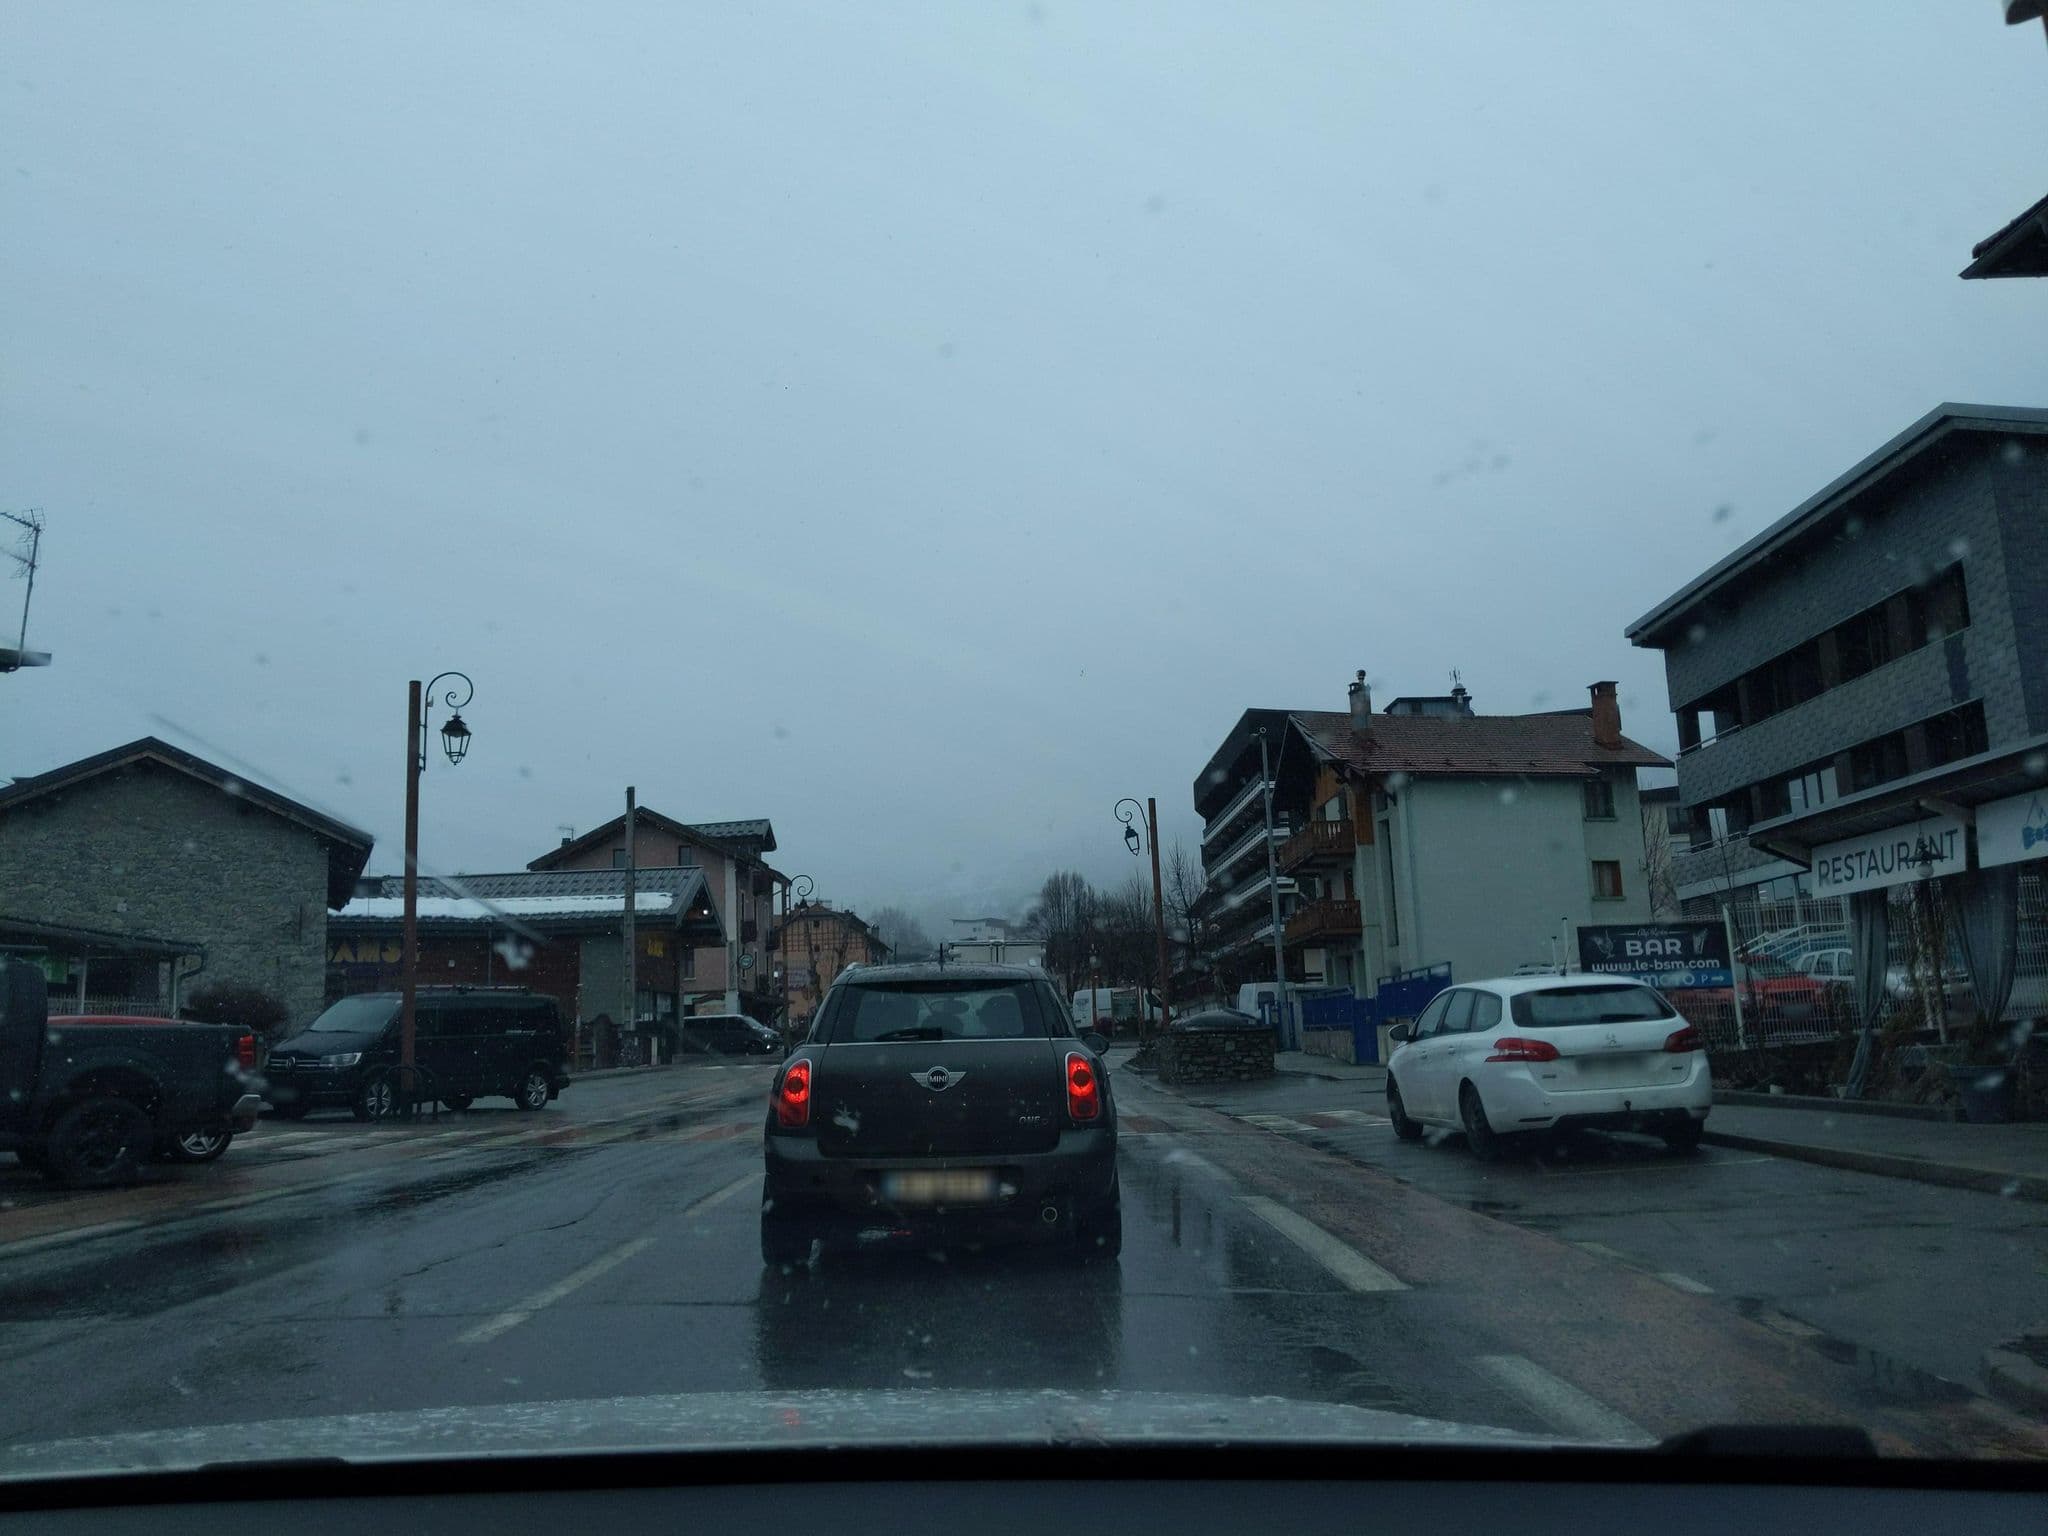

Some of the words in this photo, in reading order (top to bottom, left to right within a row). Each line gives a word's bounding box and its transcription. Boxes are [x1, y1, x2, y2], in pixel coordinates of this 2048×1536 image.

[1818, 828, 1959, 887] RESTAURANT
[1625, 938, 1683, 957] BAR
[1591, 958, 1721, 973] www.le-bsm.com
[929, 1074, 948, 1083] MINI
